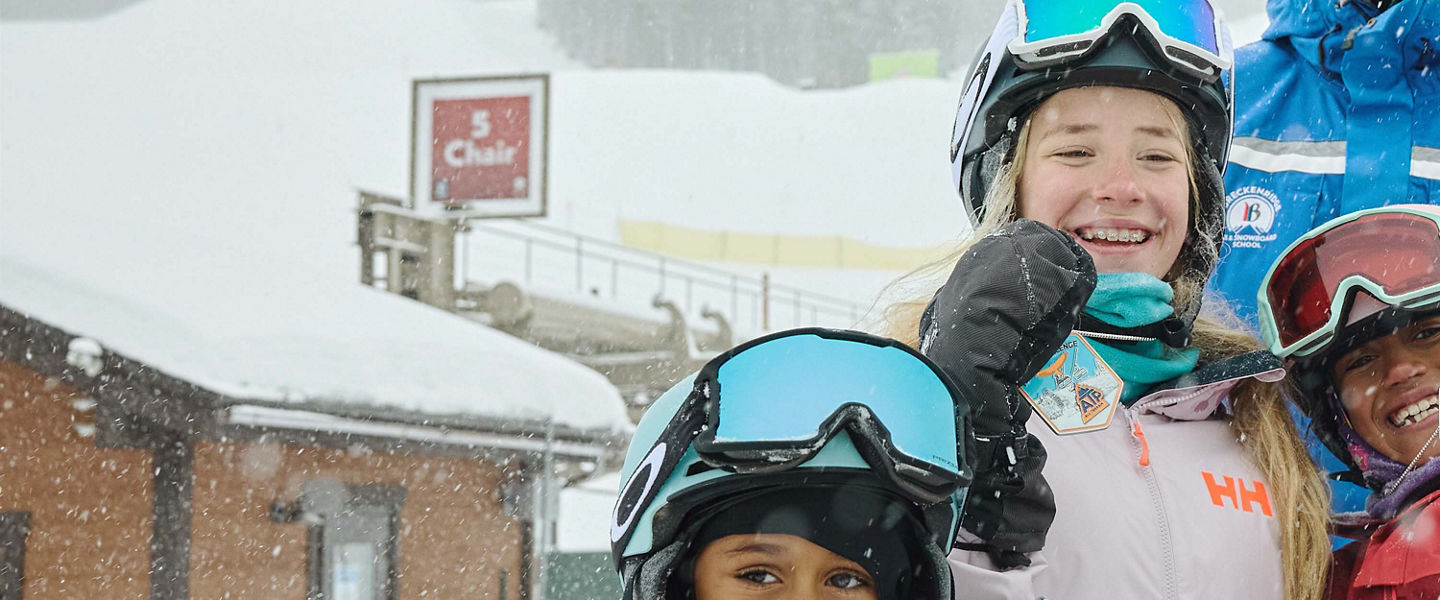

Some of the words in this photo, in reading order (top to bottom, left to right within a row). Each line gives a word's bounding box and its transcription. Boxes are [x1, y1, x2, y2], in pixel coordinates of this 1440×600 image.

[471, 109, 491, 139] 5
[444, 138, 516, 167] Chair
[1201, 471, 1273, 518] HH
